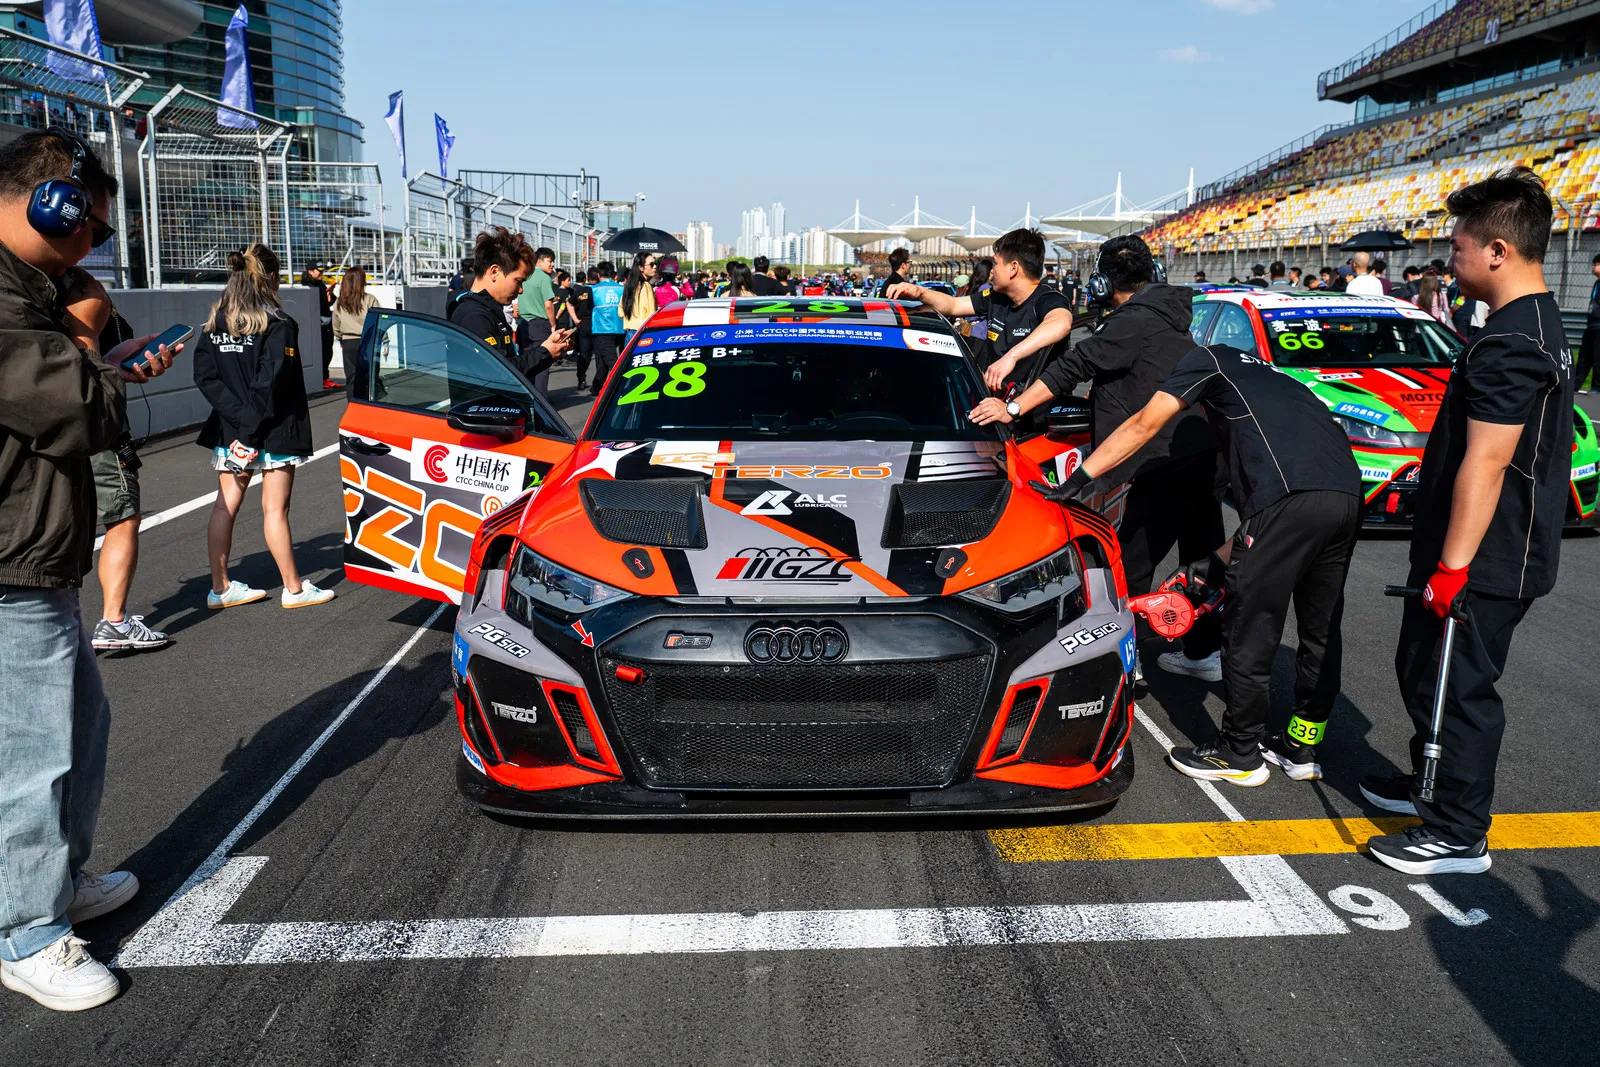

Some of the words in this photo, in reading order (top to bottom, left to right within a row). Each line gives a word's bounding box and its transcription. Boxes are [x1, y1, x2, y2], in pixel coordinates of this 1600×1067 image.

[62, 204, 80, 216] OMP
[751, 300, 850, 313] 28
[1279, 332, 1324, 350] 66
[631, 347, 701, 367] 程春华
[712, 347, 742, 359] B+
[616, 361, 708, 405] 28
[455, 453, 512, 482] 中国杯
[702, 464, 892, 480] TERZO
[1360, 469, 1390, 479] AILUN
[455, 475, 473, 486] CTCC
[473, 479, 495, 490] CHINA
[494, 483, 510, 493] CUP
[526, 471, 546, 489] 2
[793, 494, 848, 504] ALC
[490, 701, 537, 724] TERZO
[1058, 698, 1105, 720] TERZO
[1290, 719, 1318, 741] 239
